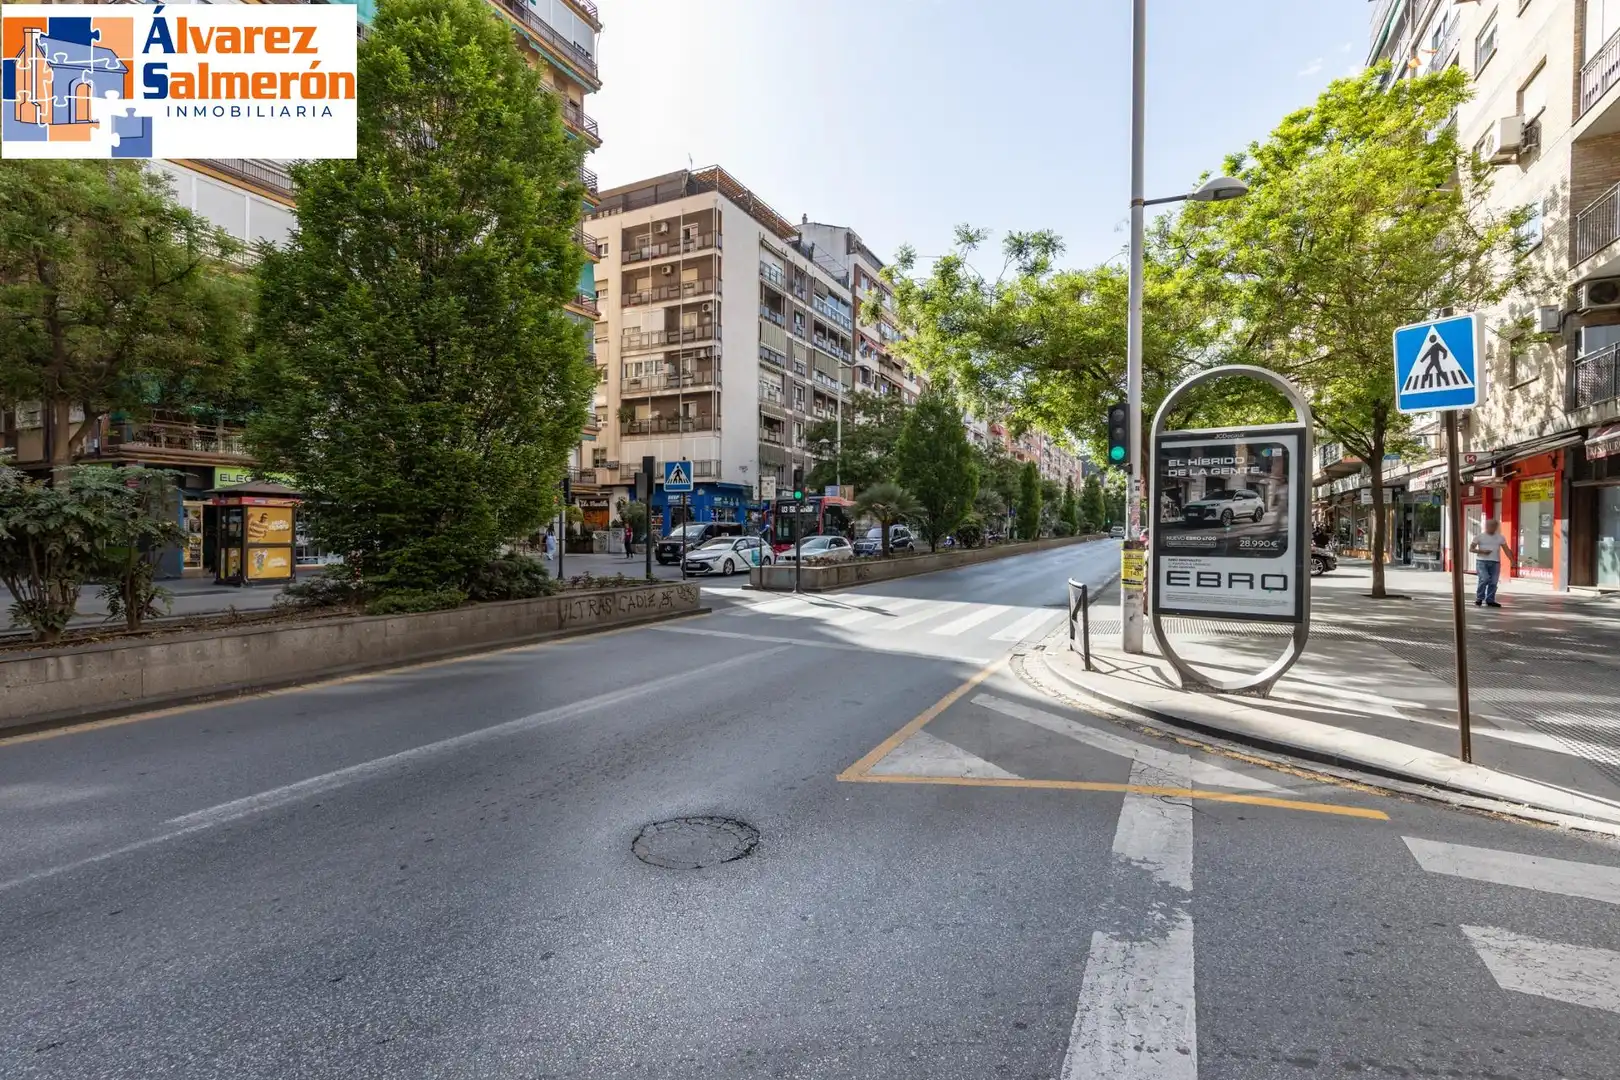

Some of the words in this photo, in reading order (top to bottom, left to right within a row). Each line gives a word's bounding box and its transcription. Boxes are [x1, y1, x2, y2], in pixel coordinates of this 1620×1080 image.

[1168, 459, 1185, 467] EL
[1188, 456, 1245, 467] HÍBRIDO
[1168, 469, 1186, 477] DE
[1189, 467, 1208, 476] LA
[1210, 466, 1264, 476] GENTE.
[1239, 539, 1278, 548] 28.990€
[1166, 570, 1288, 591] EBRO
